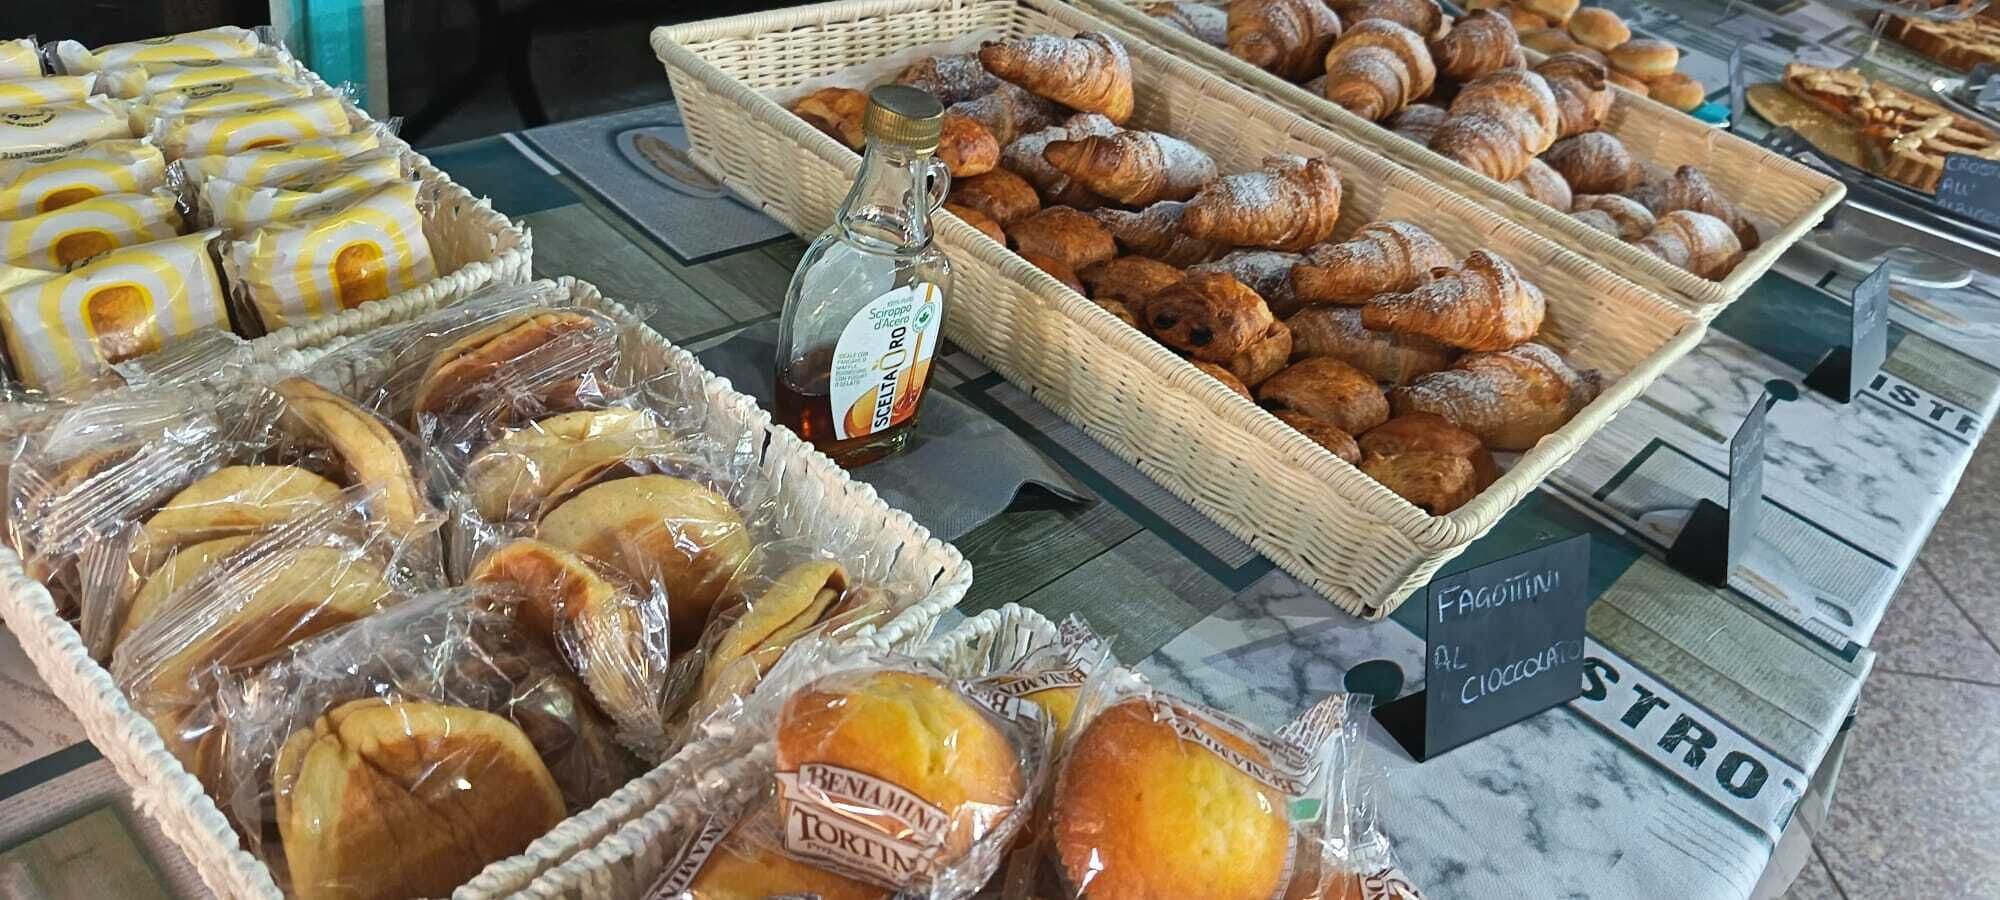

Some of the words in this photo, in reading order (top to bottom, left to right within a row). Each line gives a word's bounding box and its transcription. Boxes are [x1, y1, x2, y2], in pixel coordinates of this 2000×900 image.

[868, 304, 912, 320] Sciroppo
[874, 315, 909, 330] d'Acero
[1438, 570, 1560, 623] FAGOTTINI
[1434, 645, 1467, 670] AL
[1461, 639, 1582, 704] CIOCCOLATO
[806, 764, 944, 835] BENIAMINO
